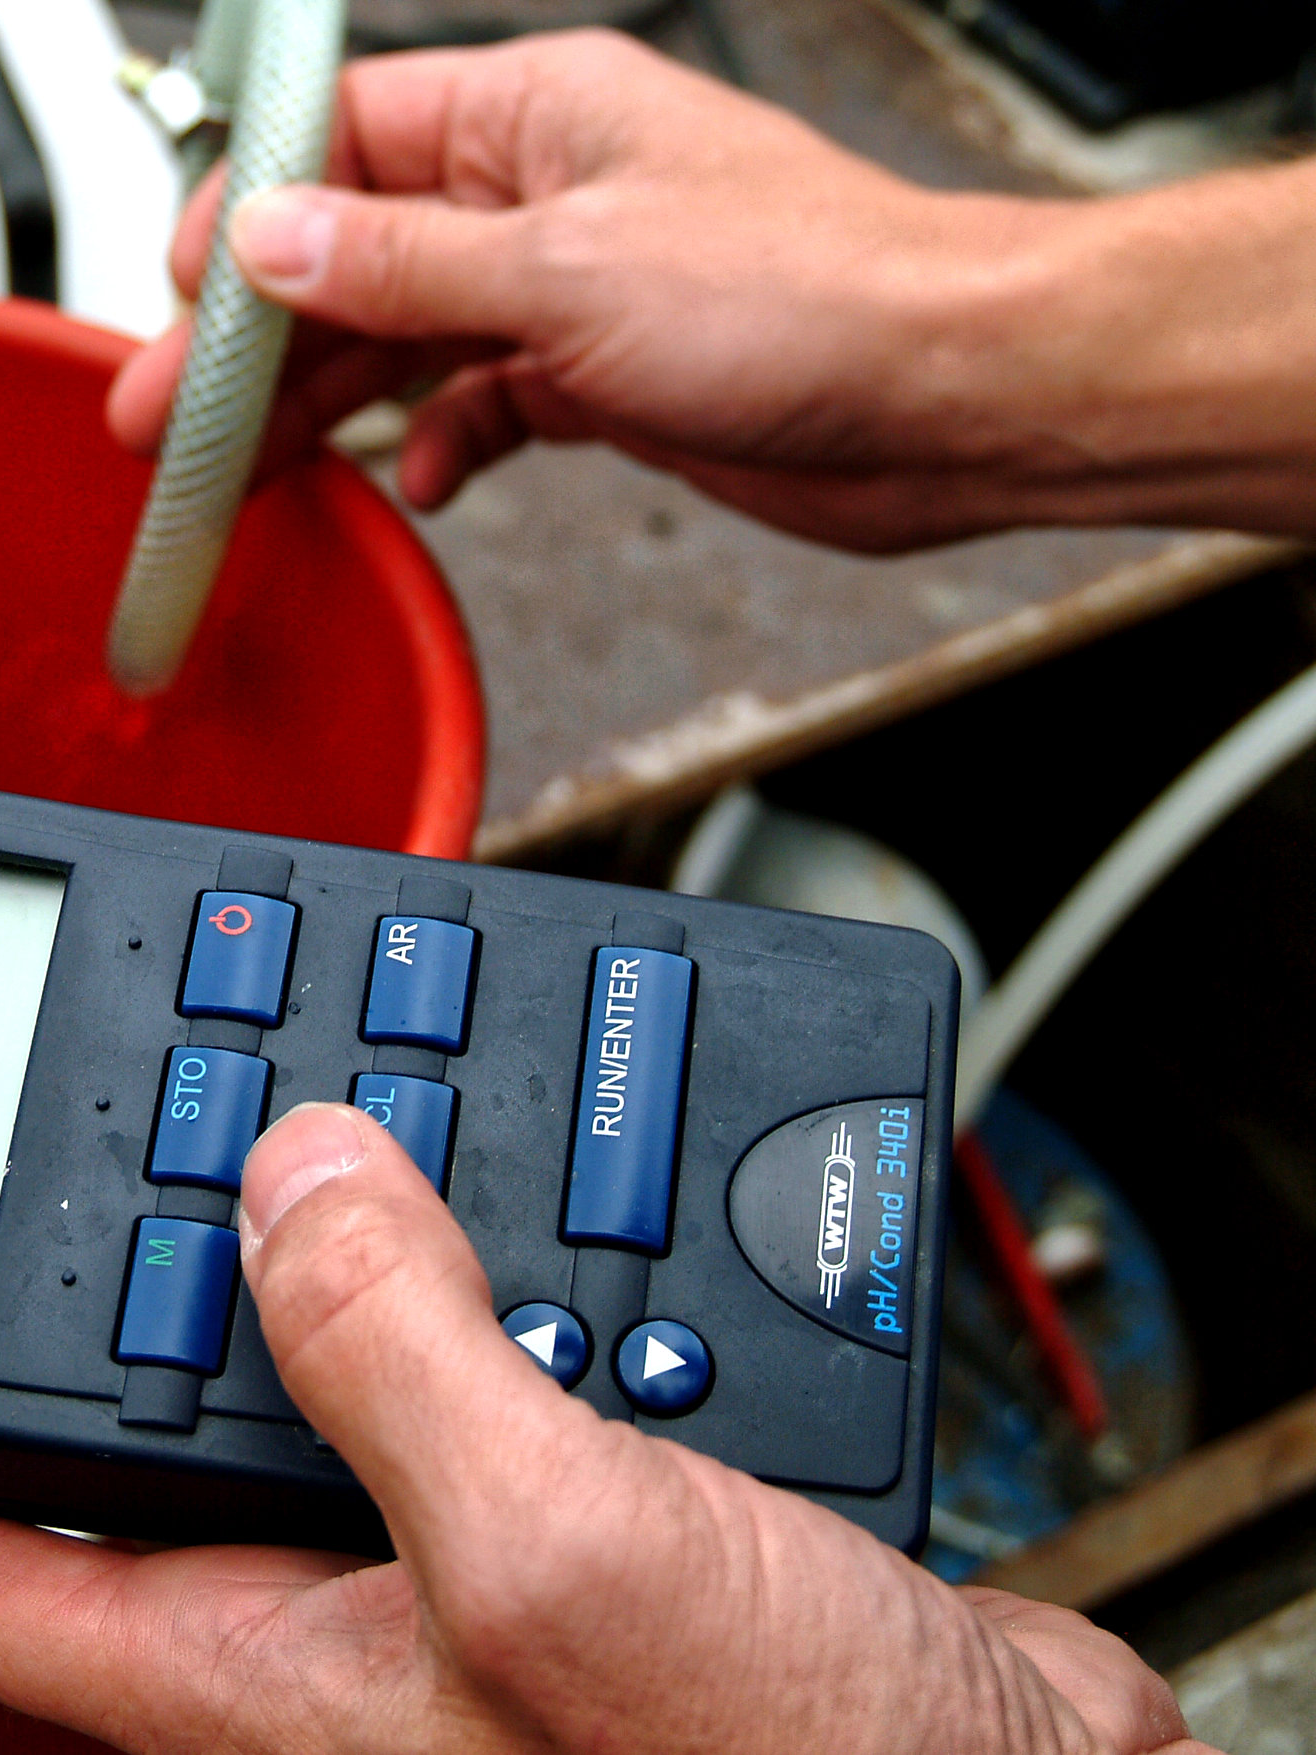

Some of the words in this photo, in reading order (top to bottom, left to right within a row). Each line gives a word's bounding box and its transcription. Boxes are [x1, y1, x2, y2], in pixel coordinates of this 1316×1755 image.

[386, 923, 418, 965] AR
[591, 957, 641, 1138] RUN/ENTER
[171, 1057, 207, 1121] STO
[365, 1087, 396, 1133] CL
[876, 1105, 910, 1178] 340i
[824, 1173, 850, 1252] WTW
[145, 1238, 176, 1267] M
[865, 1191, 904, 1333] pH/Cond
